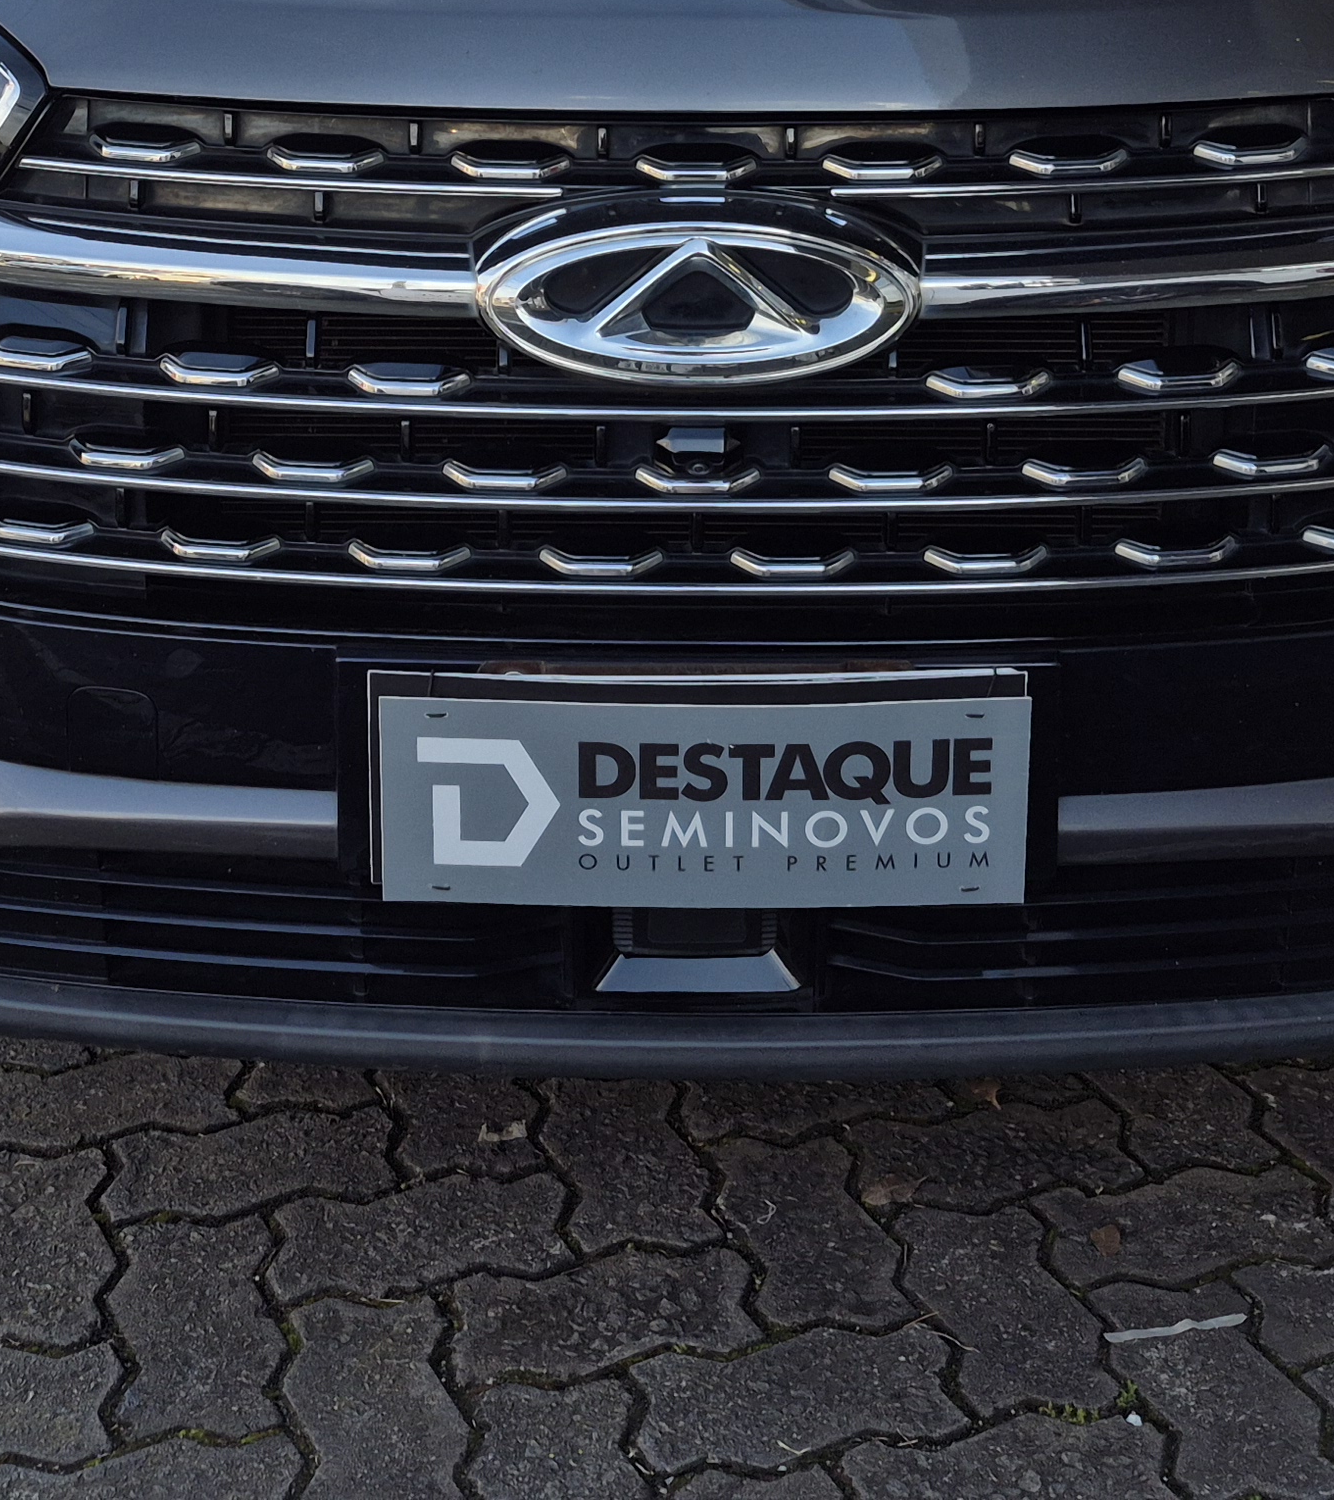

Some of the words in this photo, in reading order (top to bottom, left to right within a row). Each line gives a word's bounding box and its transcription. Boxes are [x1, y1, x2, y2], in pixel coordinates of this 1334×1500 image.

[578, 737, 993, 805] DESTAQUE
[578, 806, 991, 848] SEMINOVOS
[578, 853, 745, 873] OUTLET
[787, 850, 991, 872] PREMIUM
